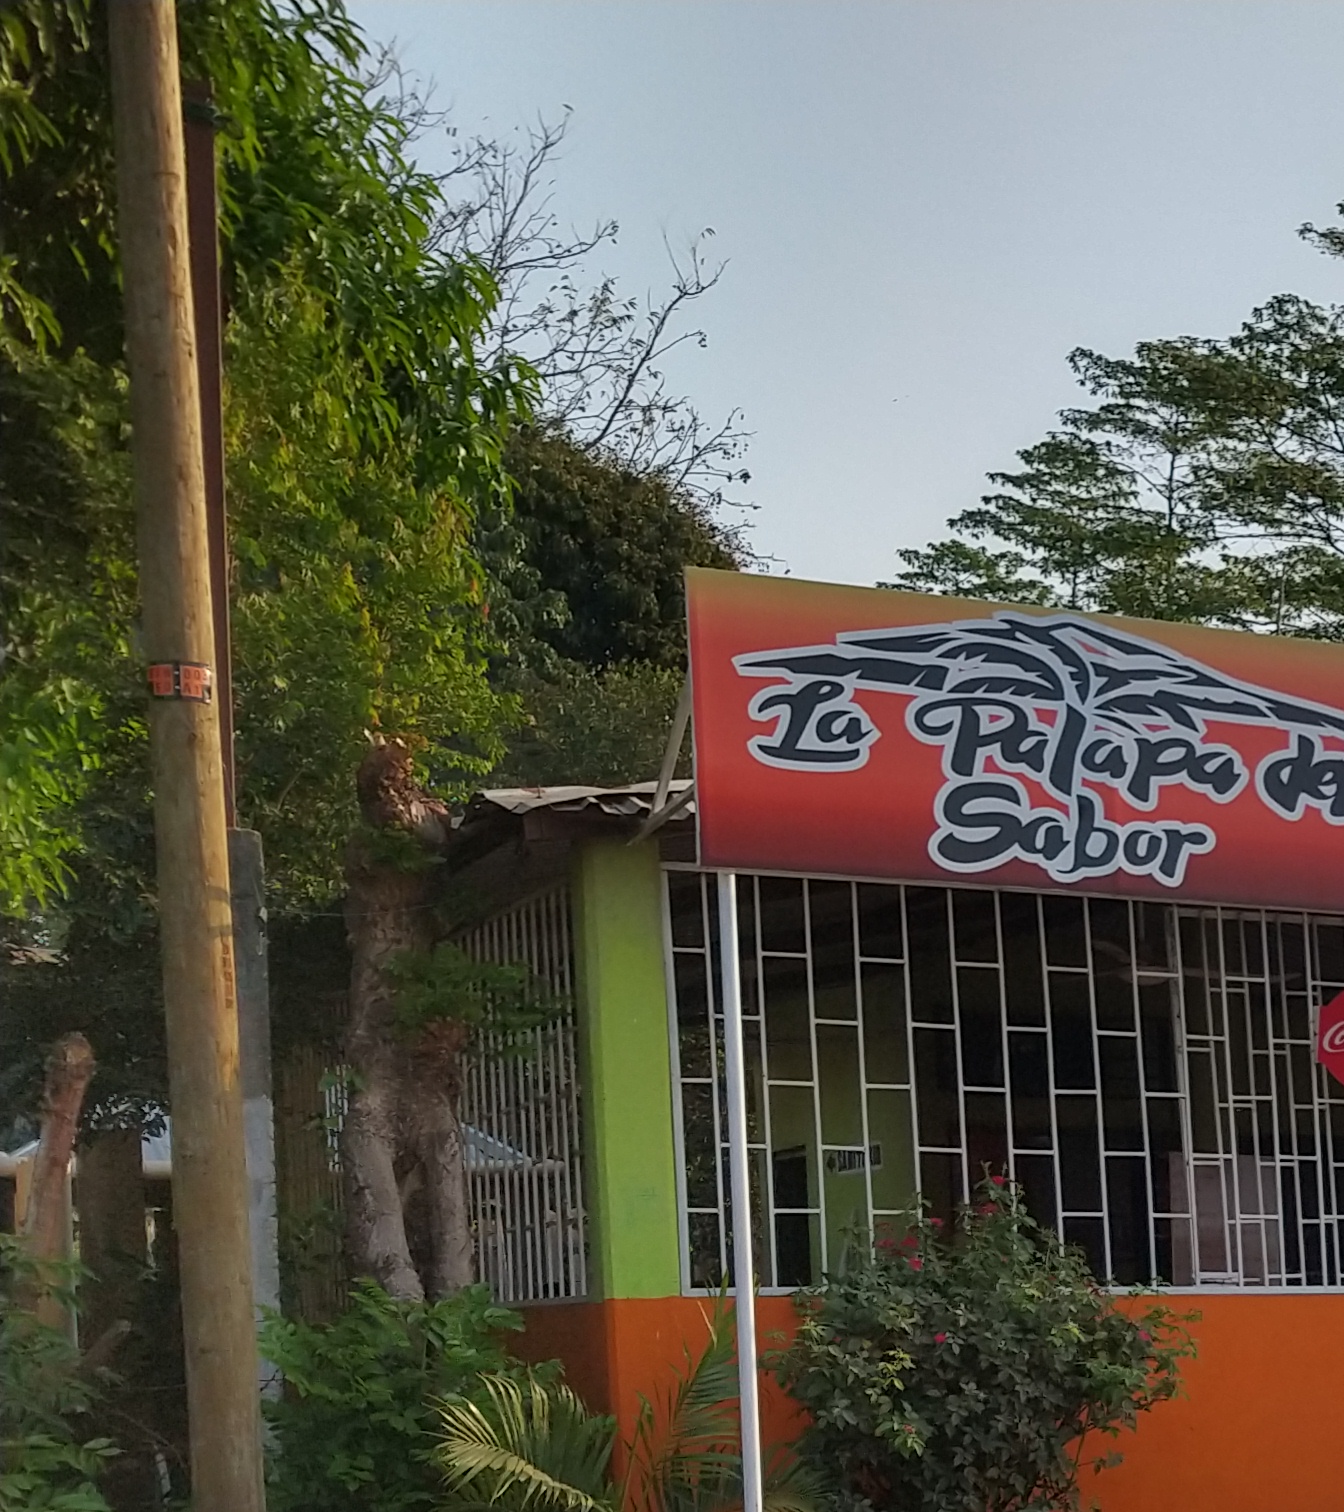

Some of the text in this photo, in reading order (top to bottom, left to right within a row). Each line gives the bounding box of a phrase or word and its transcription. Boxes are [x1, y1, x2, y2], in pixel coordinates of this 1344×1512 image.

[752, 680, 873, 763] La
[913, 698, 1243, 802] Palapa
[936, 781, 1209, 880] Sabor
